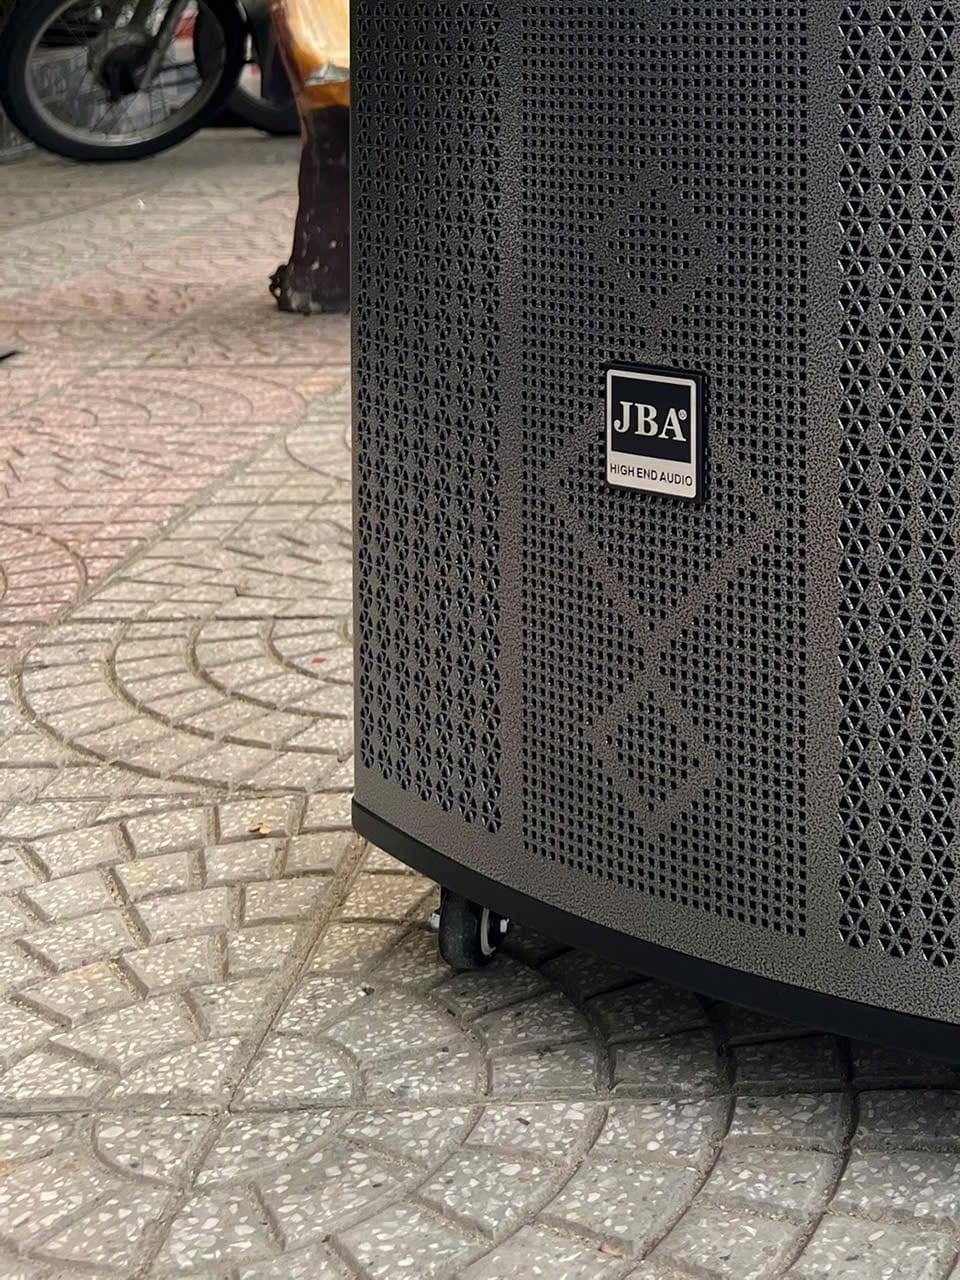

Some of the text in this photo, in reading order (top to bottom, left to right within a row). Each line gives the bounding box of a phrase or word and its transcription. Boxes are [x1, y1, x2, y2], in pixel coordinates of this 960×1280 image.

[613, 401, 687, 442] JBA
[609, 462, 693, 487] HIGH END AUDIO
